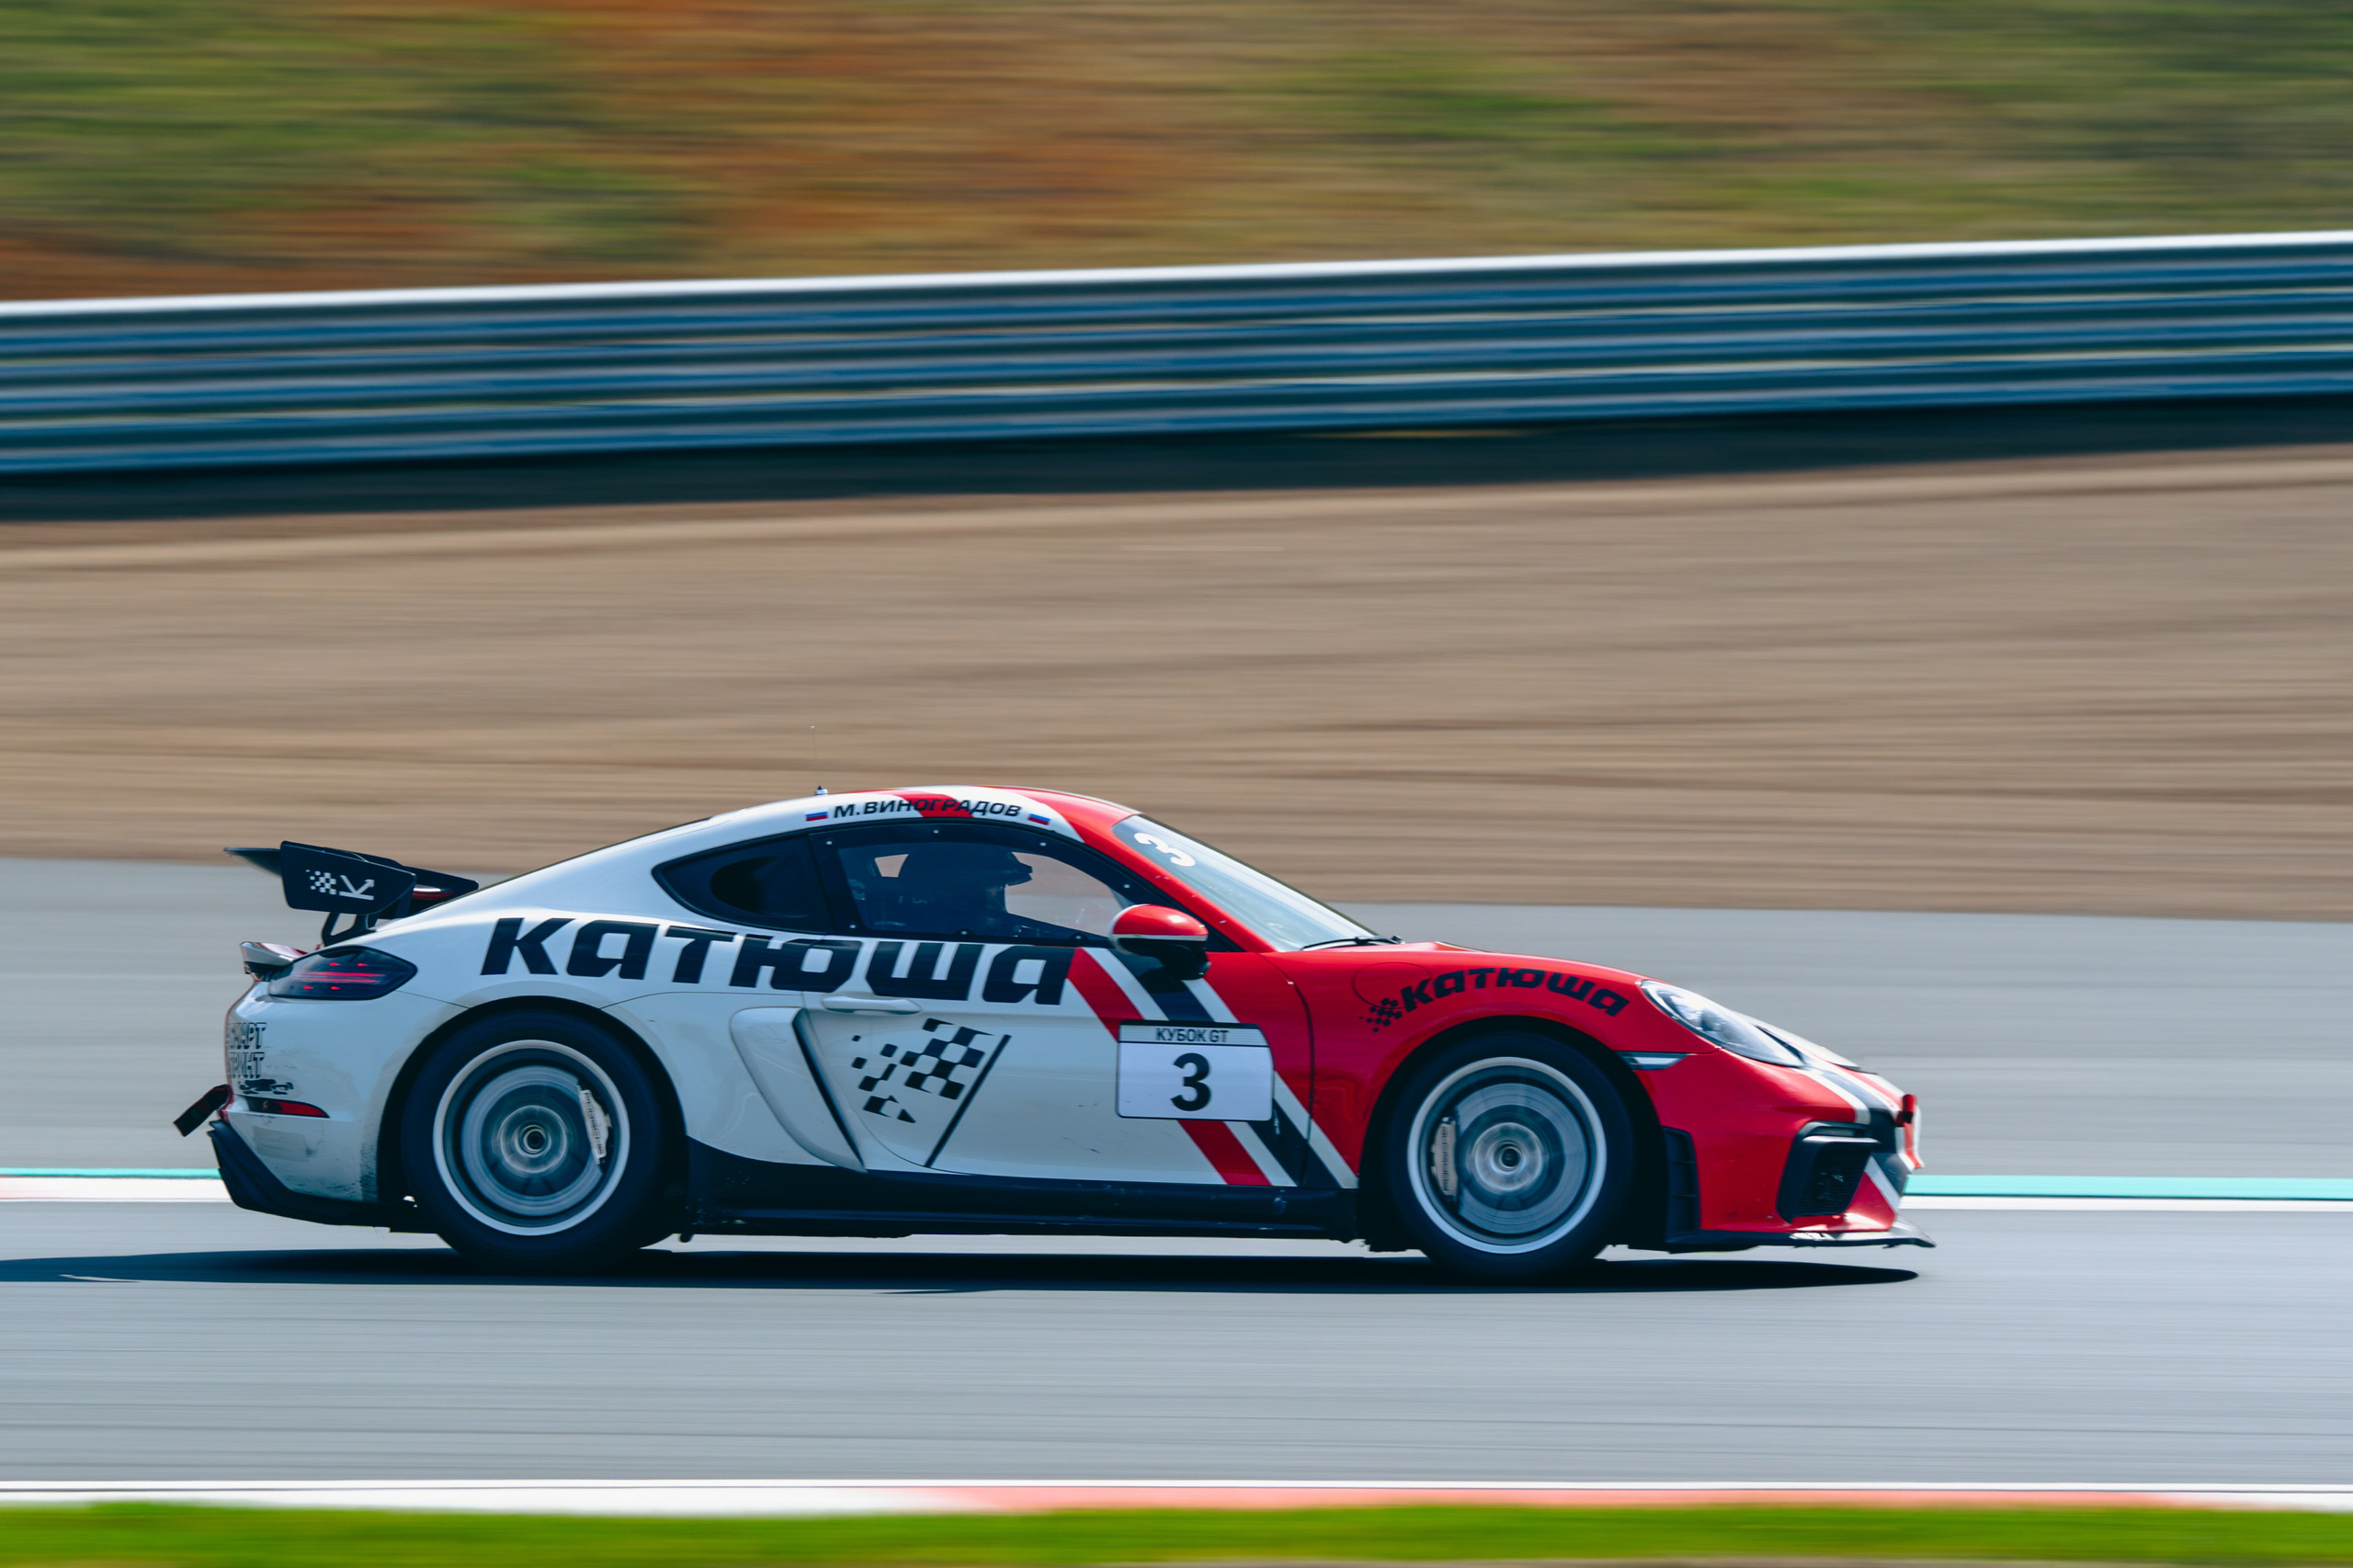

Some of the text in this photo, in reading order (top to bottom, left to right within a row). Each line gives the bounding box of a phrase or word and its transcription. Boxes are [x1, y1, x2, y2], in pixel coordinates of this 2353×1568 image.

[1133, 832, 1197, 869] 3
[481, 917, 1074, 1006] КАТЮША
[1400, 966, 1631, 1017] КАТЮША
[1155, 1028, 1230, 1043] КУБОК GT
[1170, 1051, 1212, 1112] 3
